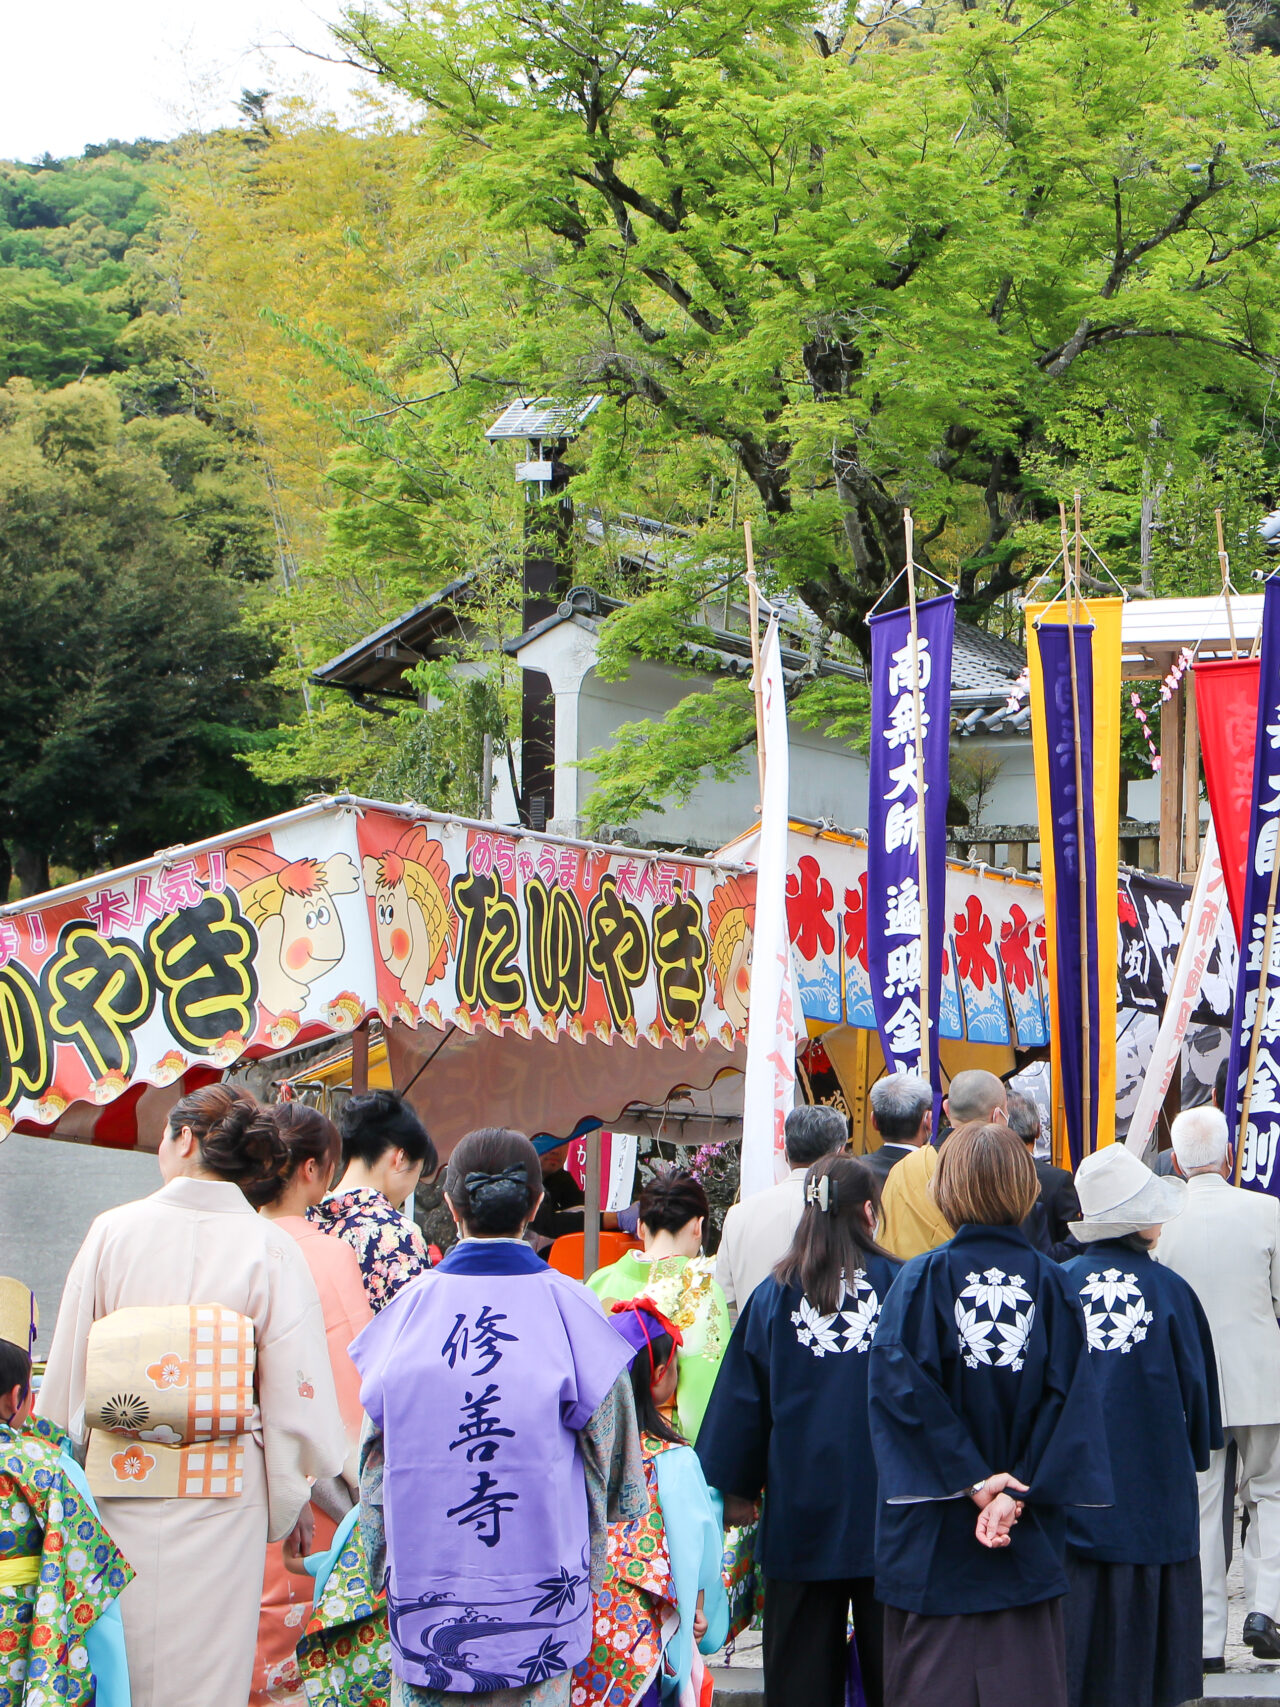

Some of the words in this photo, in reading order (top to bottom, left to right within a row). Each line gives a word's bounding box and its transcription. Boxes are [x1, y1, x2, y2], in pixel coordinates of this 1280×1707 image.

[83, 849, 227, 938] 大人気！
[471, 832, 594, 891] めちゃうま！
[615, 858, 692, 906] 大人気！
[451, 852, 708, 1036] たいやき
[953, 895, 997, 991] 氷
[1000, 904, 1034, 995] 氷
[440, 1305, 520, 1548] 修善寺
